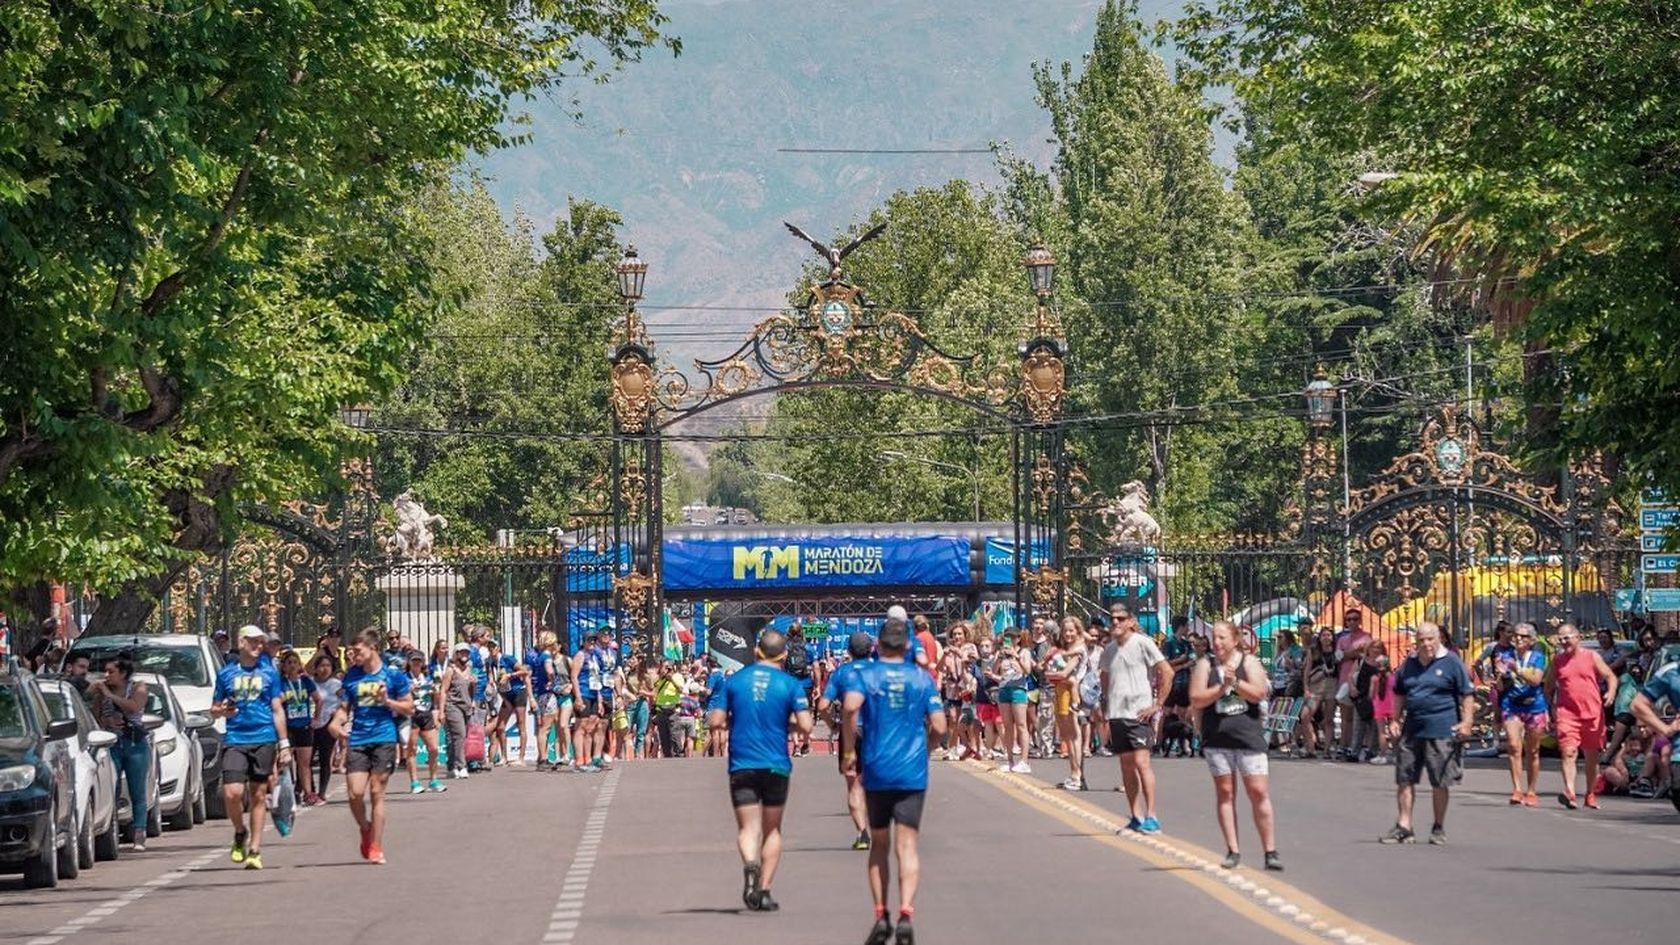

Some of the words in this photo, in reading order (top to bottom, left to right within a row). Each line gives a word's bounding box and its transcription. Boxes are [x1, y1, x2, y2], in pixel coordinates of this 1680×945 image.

[805, 544, 863, 559] MARATÓN
[866, 547, 883, 558] DE
[805, 559, 884, 575] MENDOZA
[1102, 576, 1148, 587] POWER
